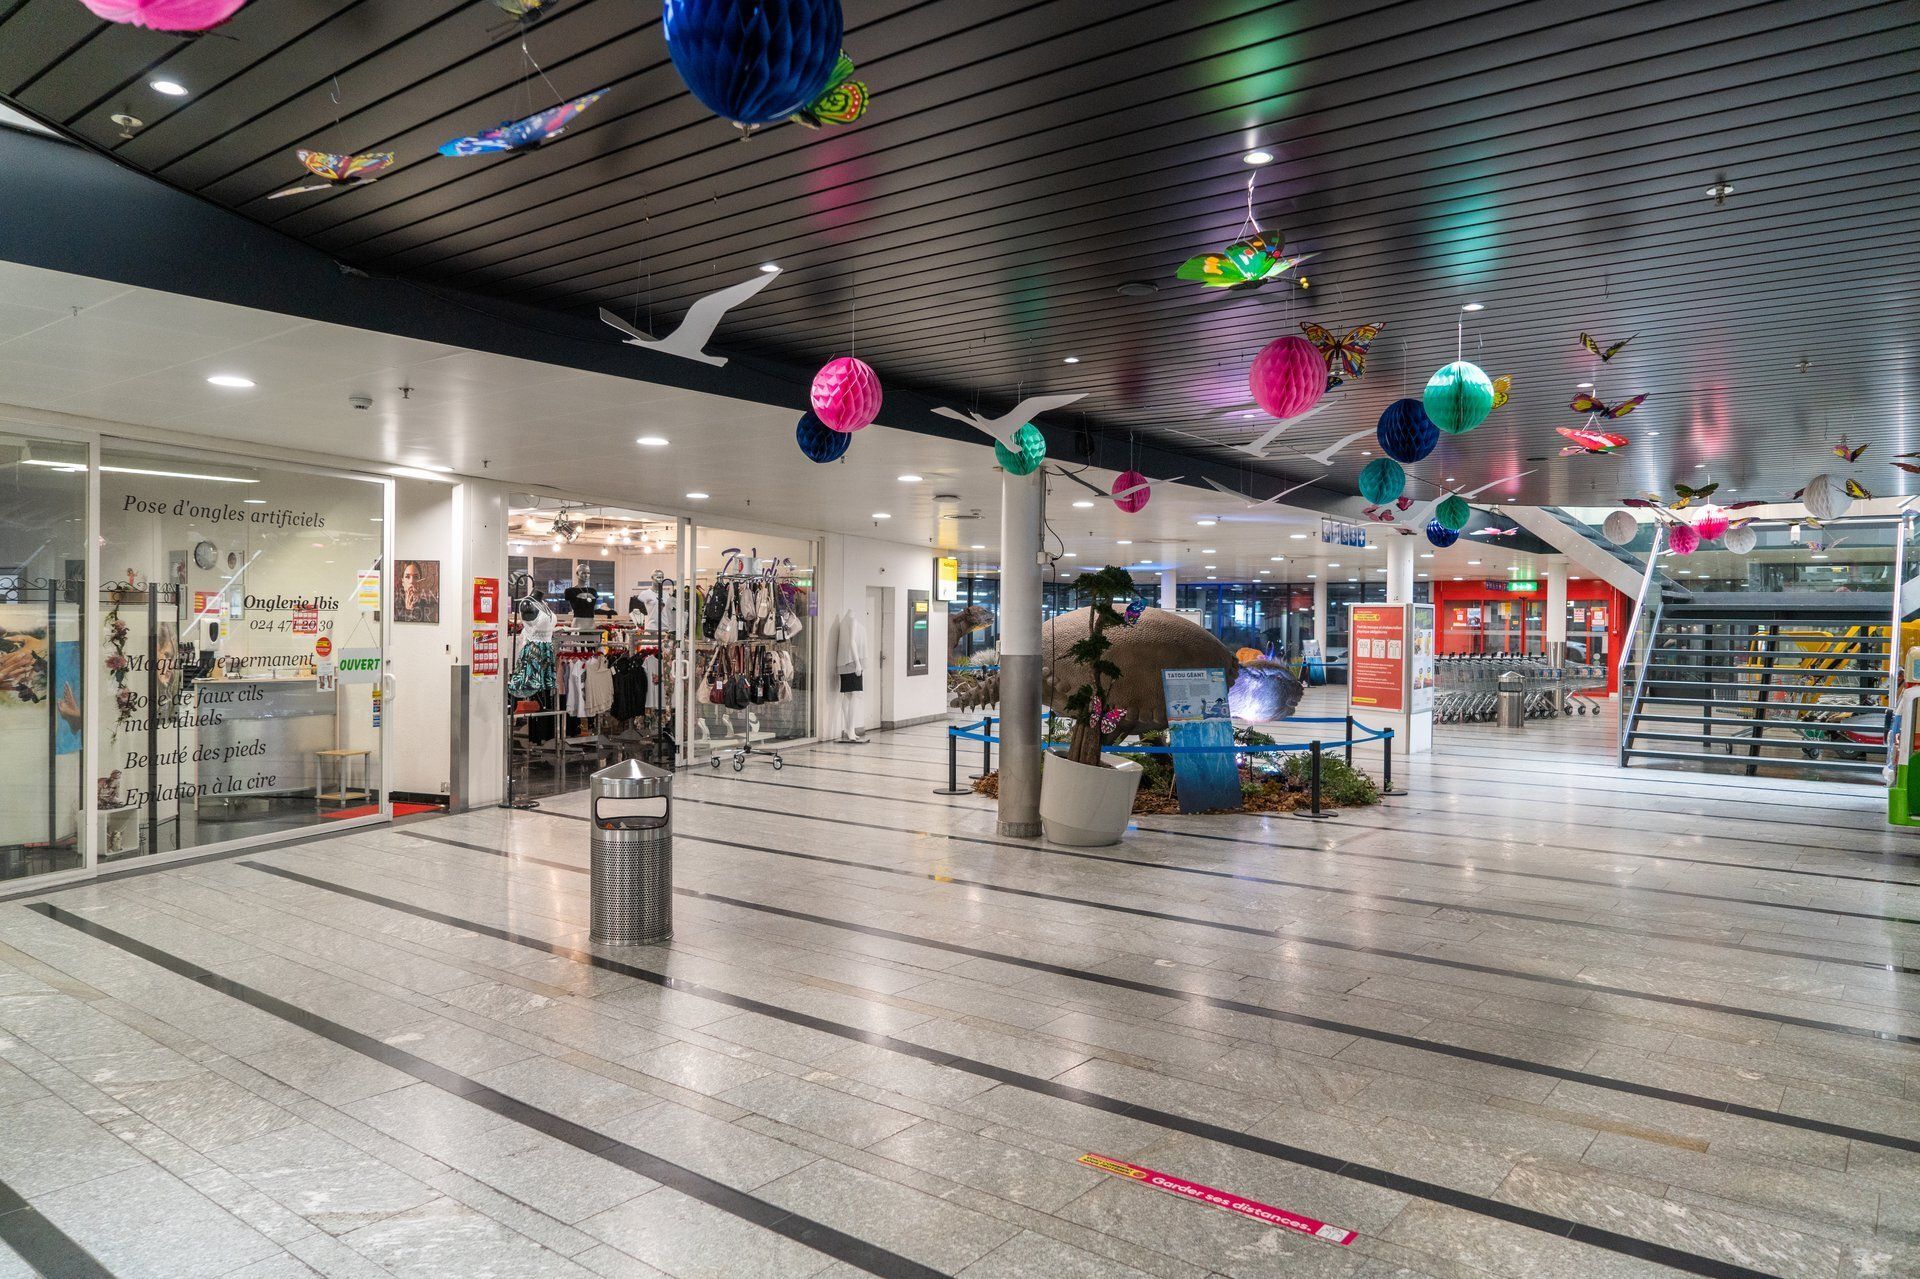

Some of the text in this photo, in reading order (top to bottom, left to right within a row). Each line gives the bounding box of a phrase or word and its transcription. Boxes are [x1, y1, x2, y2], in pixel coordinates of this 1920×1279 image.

[122, 495, 326, 528] Pose d'ongles artificiels
[243, 595, 339, 612] Onglerie Ibis
[250, 619, 273, 631] 024
[278, 619, 298, 632] 471
[318, 620, 334, 632] 30
[229, 653, 315, 673] permanent
[339, 658, 381, 671] OUVERT
[172, 689, 193, 706] de
[194, 688, 234, 708] faux
[238, 685, 264, 702] cils
[125, 709, 223, 732] individuels
[124, 739, 267, 769] Beauté des pieds
[123, 772, 277, 809] Epilation à la cire
[1151, 1177, 1312, 1232] Garder ses distances.
